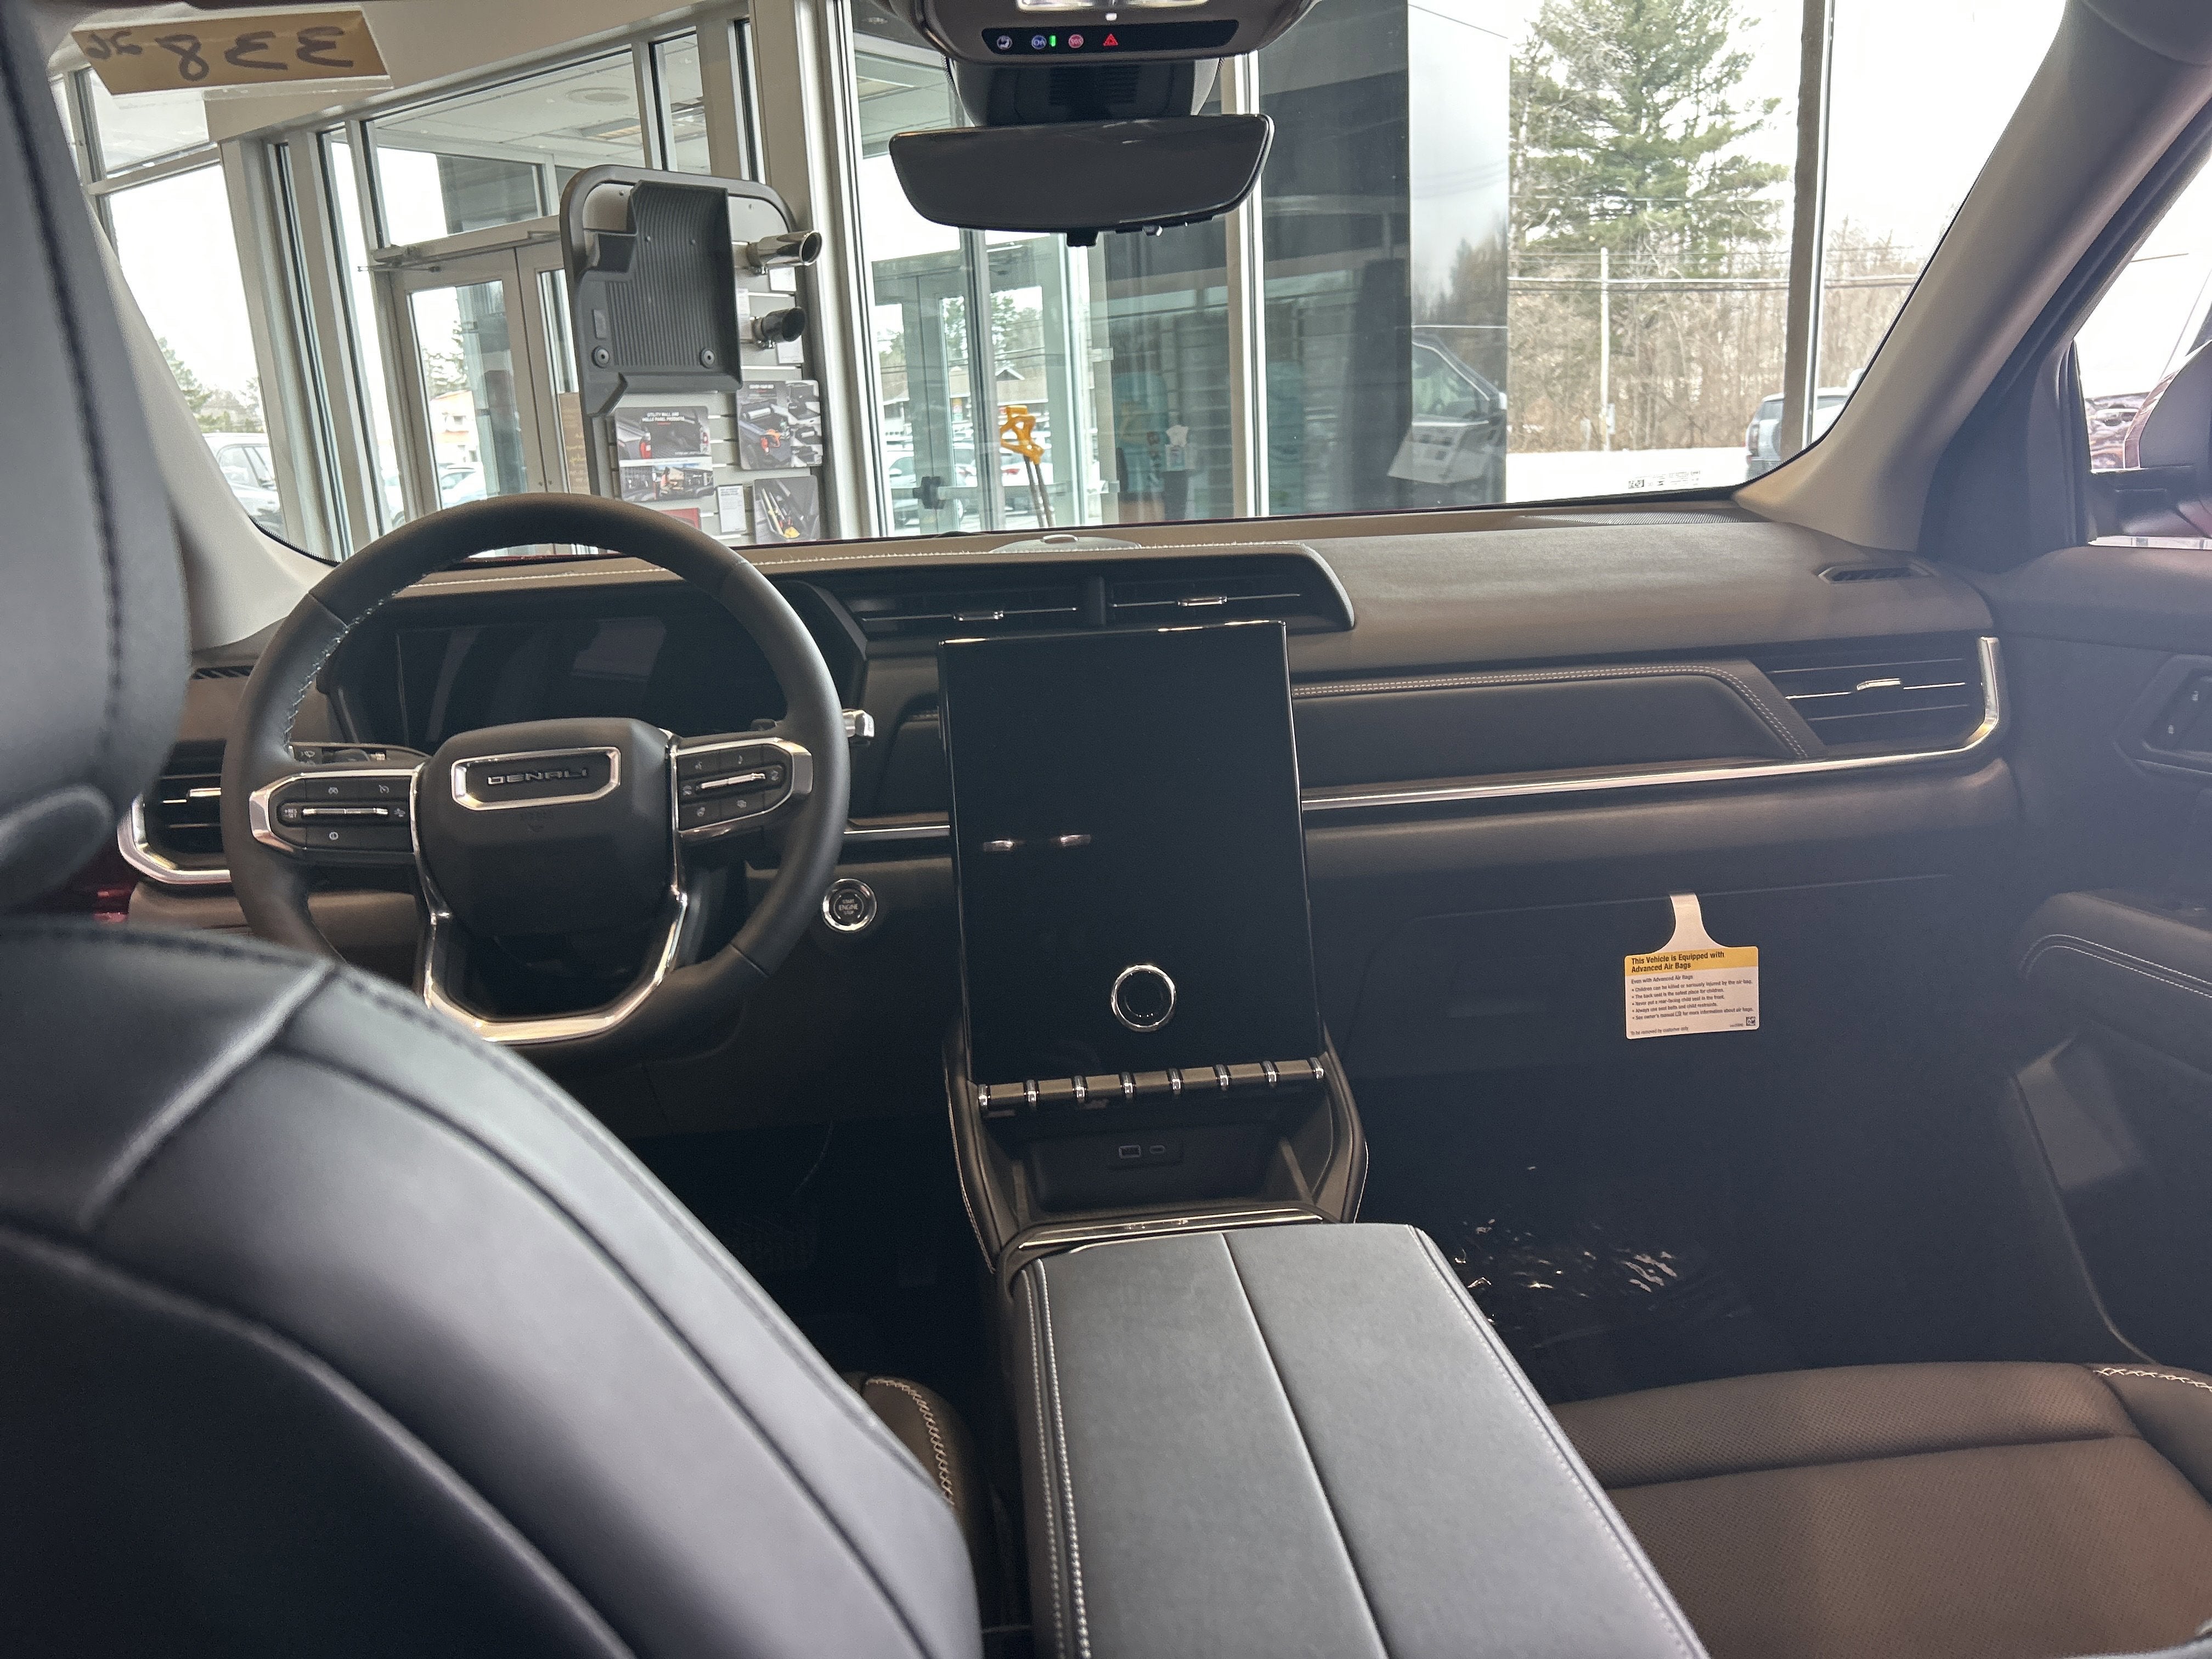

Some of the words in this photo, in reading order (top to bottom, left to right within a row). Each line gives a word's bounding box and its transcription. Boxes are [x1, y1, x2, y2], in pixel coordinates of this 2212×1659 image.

[488, 769, 587, 785] DENALI
[1679, 952, 1708, 961] Equipped
[1632, 964, 1662, 973] Advanced
